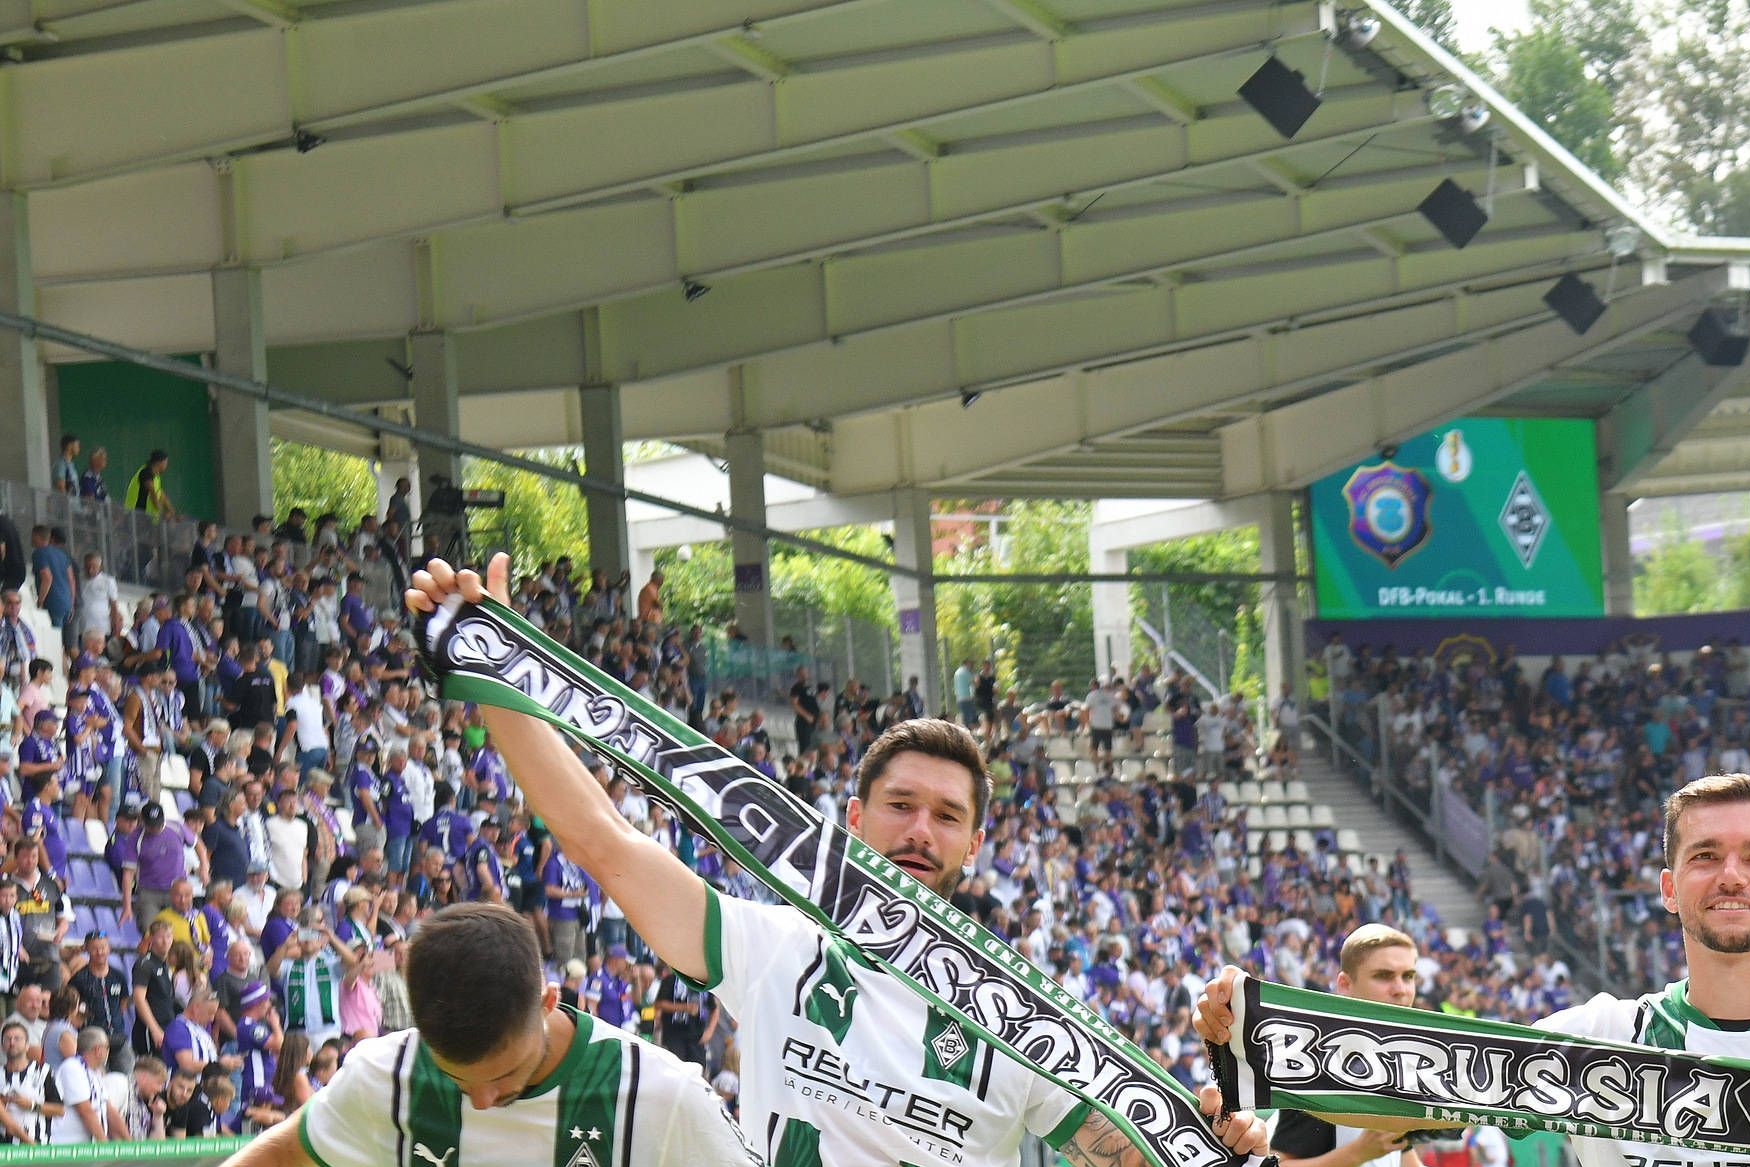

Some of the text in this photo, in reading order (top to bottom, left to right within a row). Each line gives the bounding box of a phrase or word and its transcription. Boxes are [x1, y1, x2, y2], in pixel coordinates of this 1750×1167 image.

[983, 939, 1031, 978] UND
[1039, 973, 1128, 1047] IMMER
[781, 1036, 974, 1141] REUTER
[1250, 1017, 1734, 1137] BORUSSIA
[1542, 1118, 1600, 1138] UND
